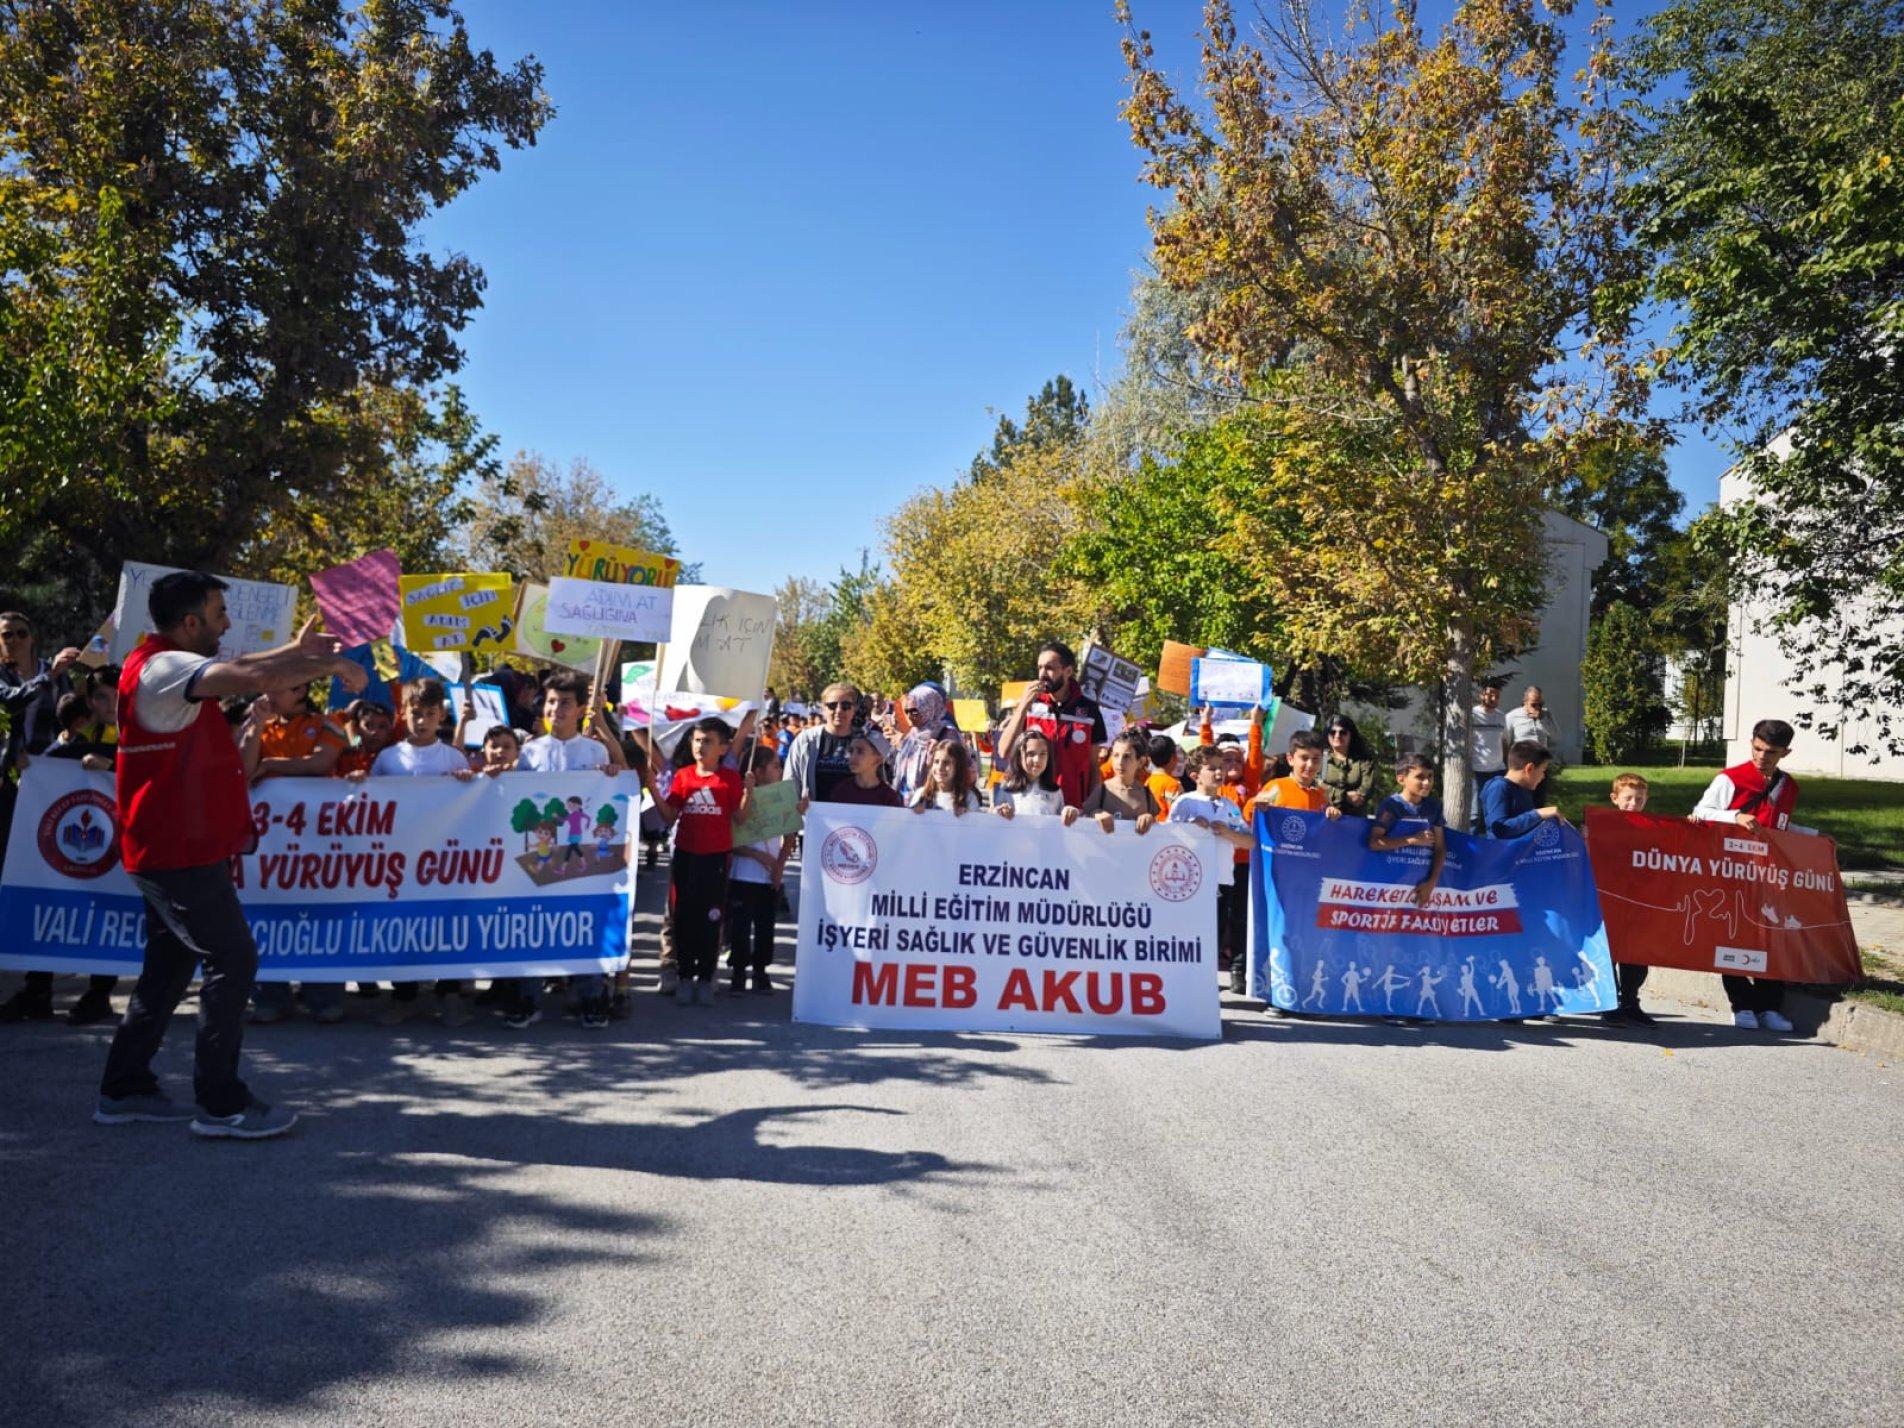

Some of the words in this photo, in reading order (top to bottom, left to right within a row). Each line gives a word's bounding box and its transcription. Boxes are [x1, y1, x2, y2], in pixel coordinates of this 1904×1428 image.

[317, 792, 397, 836] EKİM
[683, 803, 722, 816] adidas
[259, 843, 406, 899] YÜRÜYÜŞ
[415, 838, 505, 886] GÜNÜ
[959, 861, 1070, 890] ERZİNCAN
[1632, 848, 1702, 876] DÜNYA
[1708, 857, 1789, 890] YÜRÜYÜŞ
[1793, 868, 1835, 893] GÜNÜ
[871, 890, 928, 919] MİLLİ
[934, 893, 1010, 923] EĞİTİM
[1018, 898, 1152, 929] MÜDÜRLÜĞÜ
[1476, 890, 1498, 905] VE
[33, 901, 95, 944] VALİ
[100, 908, 149, 949] REC
[250, 910, 344, 956] CIOĞLU
[349, 910, 470, 954] İLKOKULU
[477, 905, 594, 950] YÜRÜYOR
[817, 918, 889, 952] İŞYERİ
[896, 926, 975, 955] SAĞLIK
[983, 933, 1010, 956] VE
[1018, 931, 1128, 961] GÜVENLİK
[1135, 934, 1202, 964] BİRİMİ
[852, 960, 978, 1009] MEB
[997, 968, 1166, 1016] AKUB
